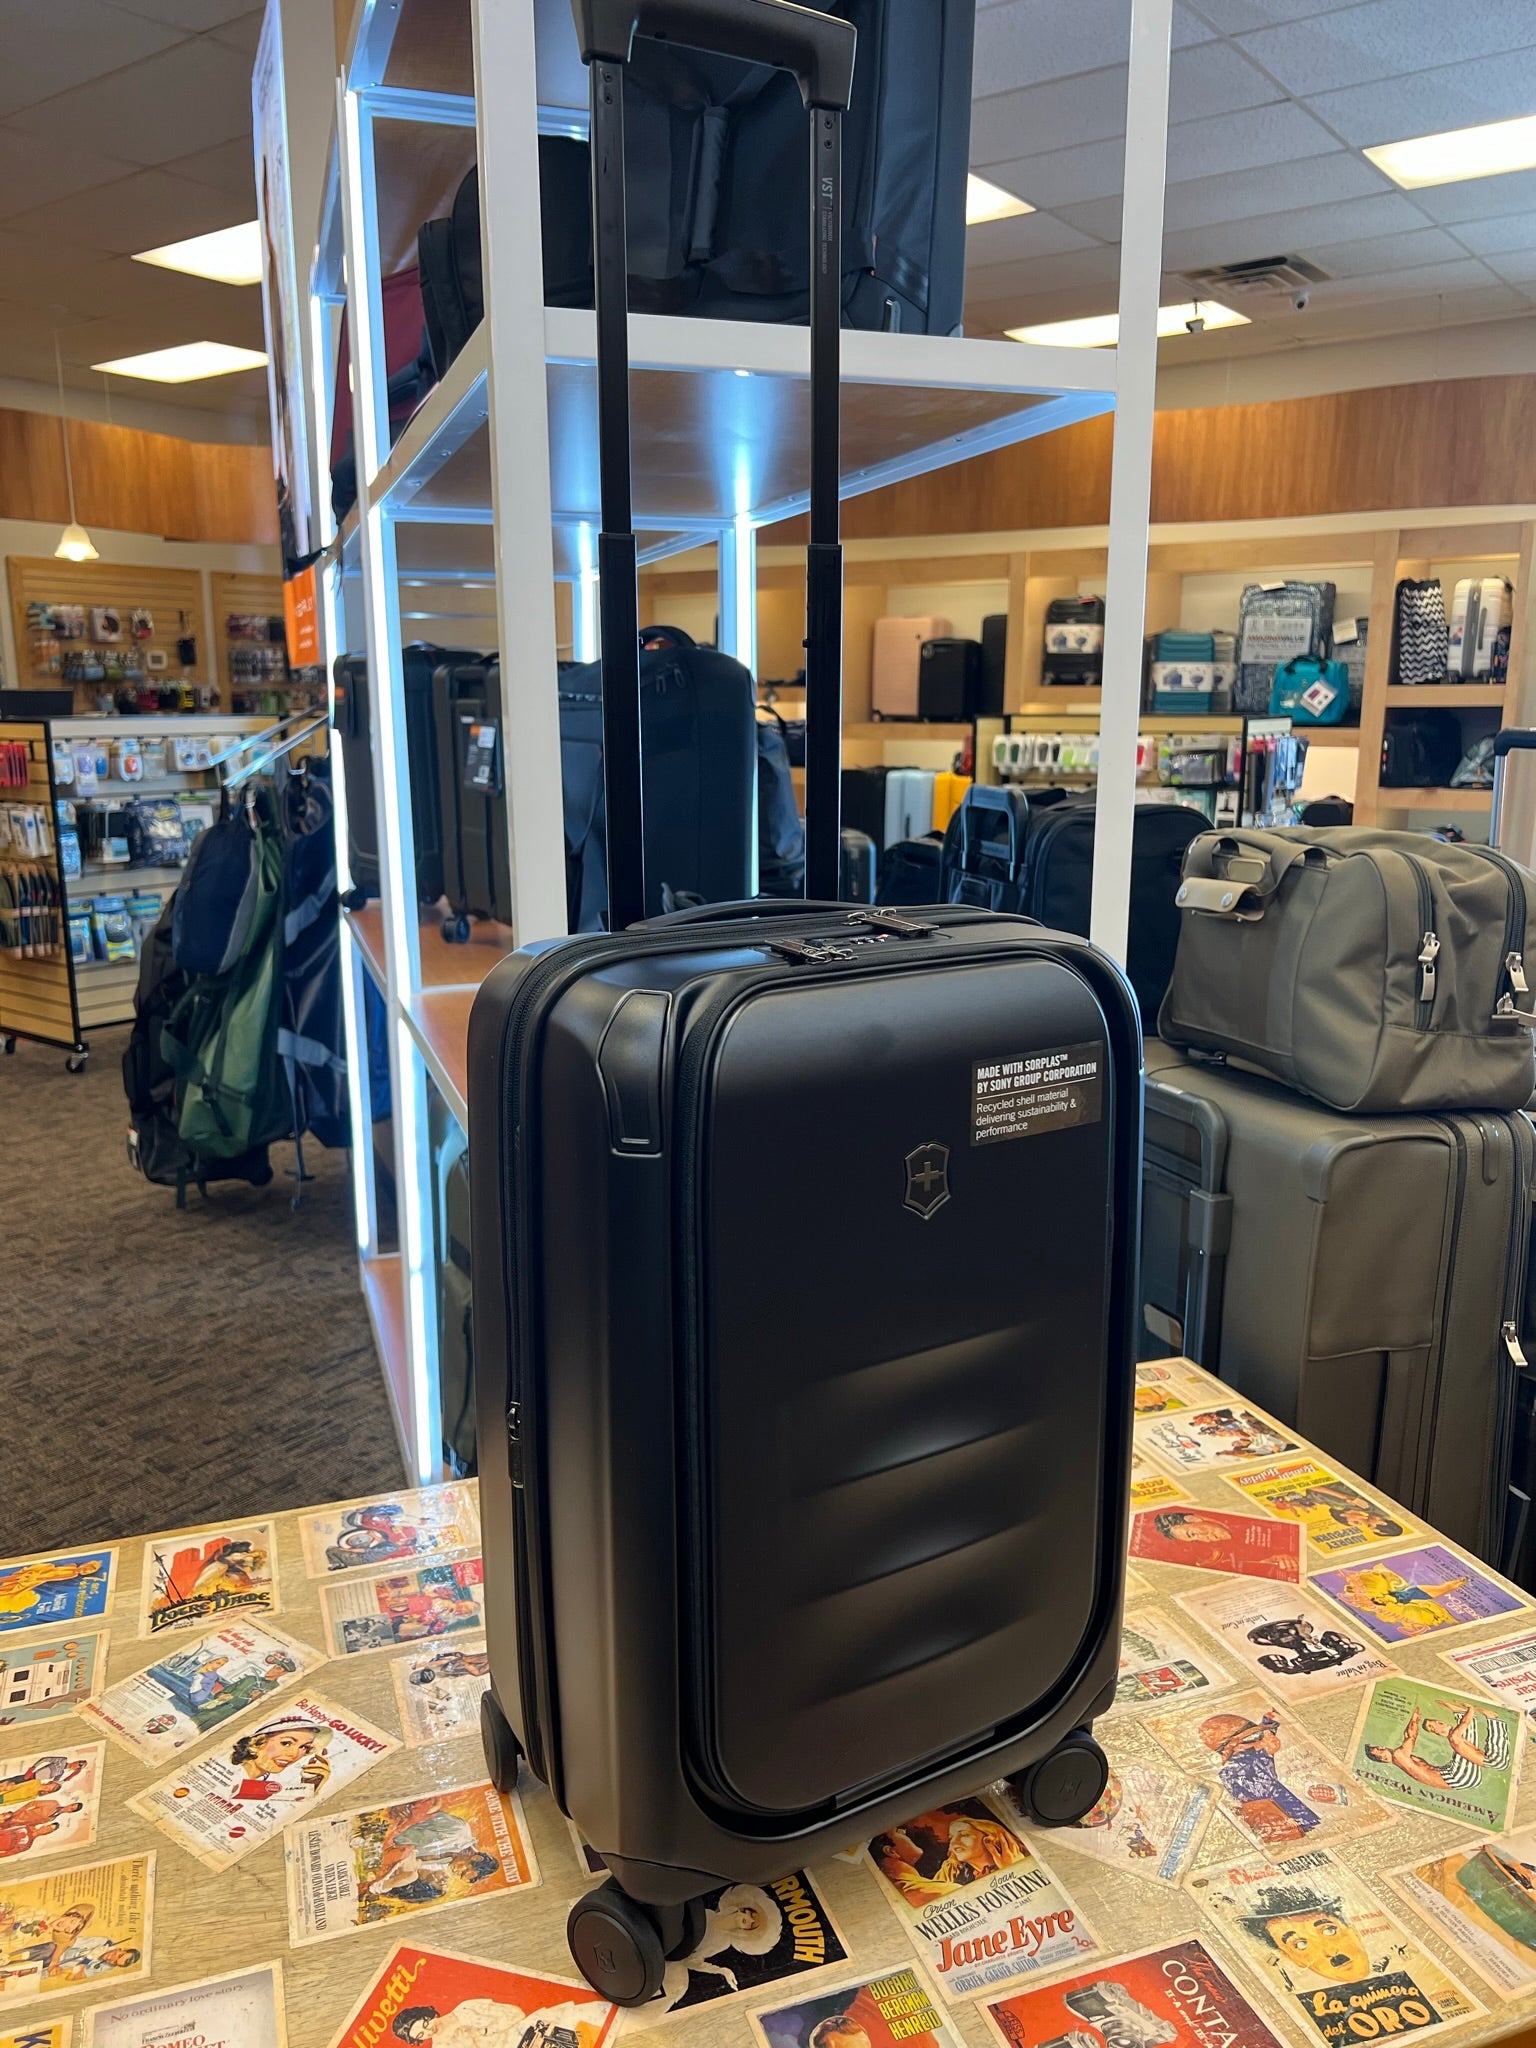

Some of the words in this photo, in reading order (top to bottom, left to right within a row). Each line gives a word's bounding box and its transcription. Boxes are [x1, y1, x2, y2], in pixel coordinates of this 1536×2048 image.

[977, 1065, 1001, 1080] MADE
[1002, 1061, 1023, 1076] WITH
[977, 1081, 989, 1094] BY
[990, 1077, 1012, 1092] SONY
[1013, 1072, 1041, 1088] GROUP
[1043, 1062, 1097, 1082] CORPORATION
[976, 1097, 1014, 1114] Recycled
[1016, 1094, 1035, 1107] shell
[1037, 1087, 1068, 1103] material
[976, 1110, 1016, 1127] delivering
[1018, 1100, 1068, 1119] sustainability
[1069, 1098, 1077, 1108] &
[976, 1122, 1028, 1140] performance
[1240, 1467, 1279, 1486] Holiday
[1279, 1464, 1316, 1480] Roman
[1311, 1527, 1361, 1543] HEPBURN
[1327, 1534, 1368, 1551] AUDREY
[82, 1569, 107, 1583] 7
[148, 1602, 209, 1628] NOTRE
[213, 1592, 270, 1613] DAME
[1444, 1593, 1484, 1619] SKELTON
[1445, 1602, 1465, 1615] RED
[1220, 1619, 1237, 1631] Cost
[1244, 1613, 1268, 1626] Little
[1336, 1663, 1359, 1678] Value
[1370, 1659, 1388, 1675] Big
[295, 1699, 309, 1710] Be
[343, 1726, 388, 1754] LUCKY!
[1353, 1768, 1413, 1796] WEEKLY
[484, 1789, 503, 1813] GONE
[1418, 1788, 1501, 1825] AMERICAN
[491, 1812, 509, 1840] WITH
[308, 1829, 321, 1850] LESLIE
[496, 1838, 512, 1857] THE
[130, 1858, 145, 1883] There's
[309, 1848, 322, 1873] HOWARD
[337, 1859, 349, 1881] CLARK
[502, 1856, 522, 1884] WIND
[311, 1872, 324, 1893] OLIVIA
[323, 1863, 336, 1885] VIVIEN
[989, 1871, 1017, 1889] Joan
[128, 1882, 143, 1911] nothing
[325, 1882, 338, 1902] LEIGH
[338, 1879, 351, 1899] GABLE
[115, 1903, 126, 1927] nothing
[914, 1901, 981, 1942] WELLES
[976, 1868, 1051, 1913] FONTAINE
[922, 1899, 958, 1919] Orson
[128, 1926, 138, 1934] it
[129, 1911, 141, 1926] like
[935, 1928, 1009, 1973] Jane
[1006, 1908, 1076, 1957] Eyre
[985, 1966, 1013, 1984] GARNER
[1014, 1956, 1041, 1974] SUTTON
[868, 1969, 919, 2001] BOGART
[109, 2011, 130, 2024] No
[130, 1999, 187, 2019] ordinary
[188, 1990, 213, 2005] love
[352, 1957, 428, 2048] livetti
[877, 1988, 933, 2021] BERGMAN
[1161, 1960, 1243, 2048] CONTA
[1312, 1991, 1348, 2017] La
[1349, 1985, 1420, 2011] quimera
[888, 2008, 943, 2041] HENREID
[1347, 2000, 1431, 2038] ORO
